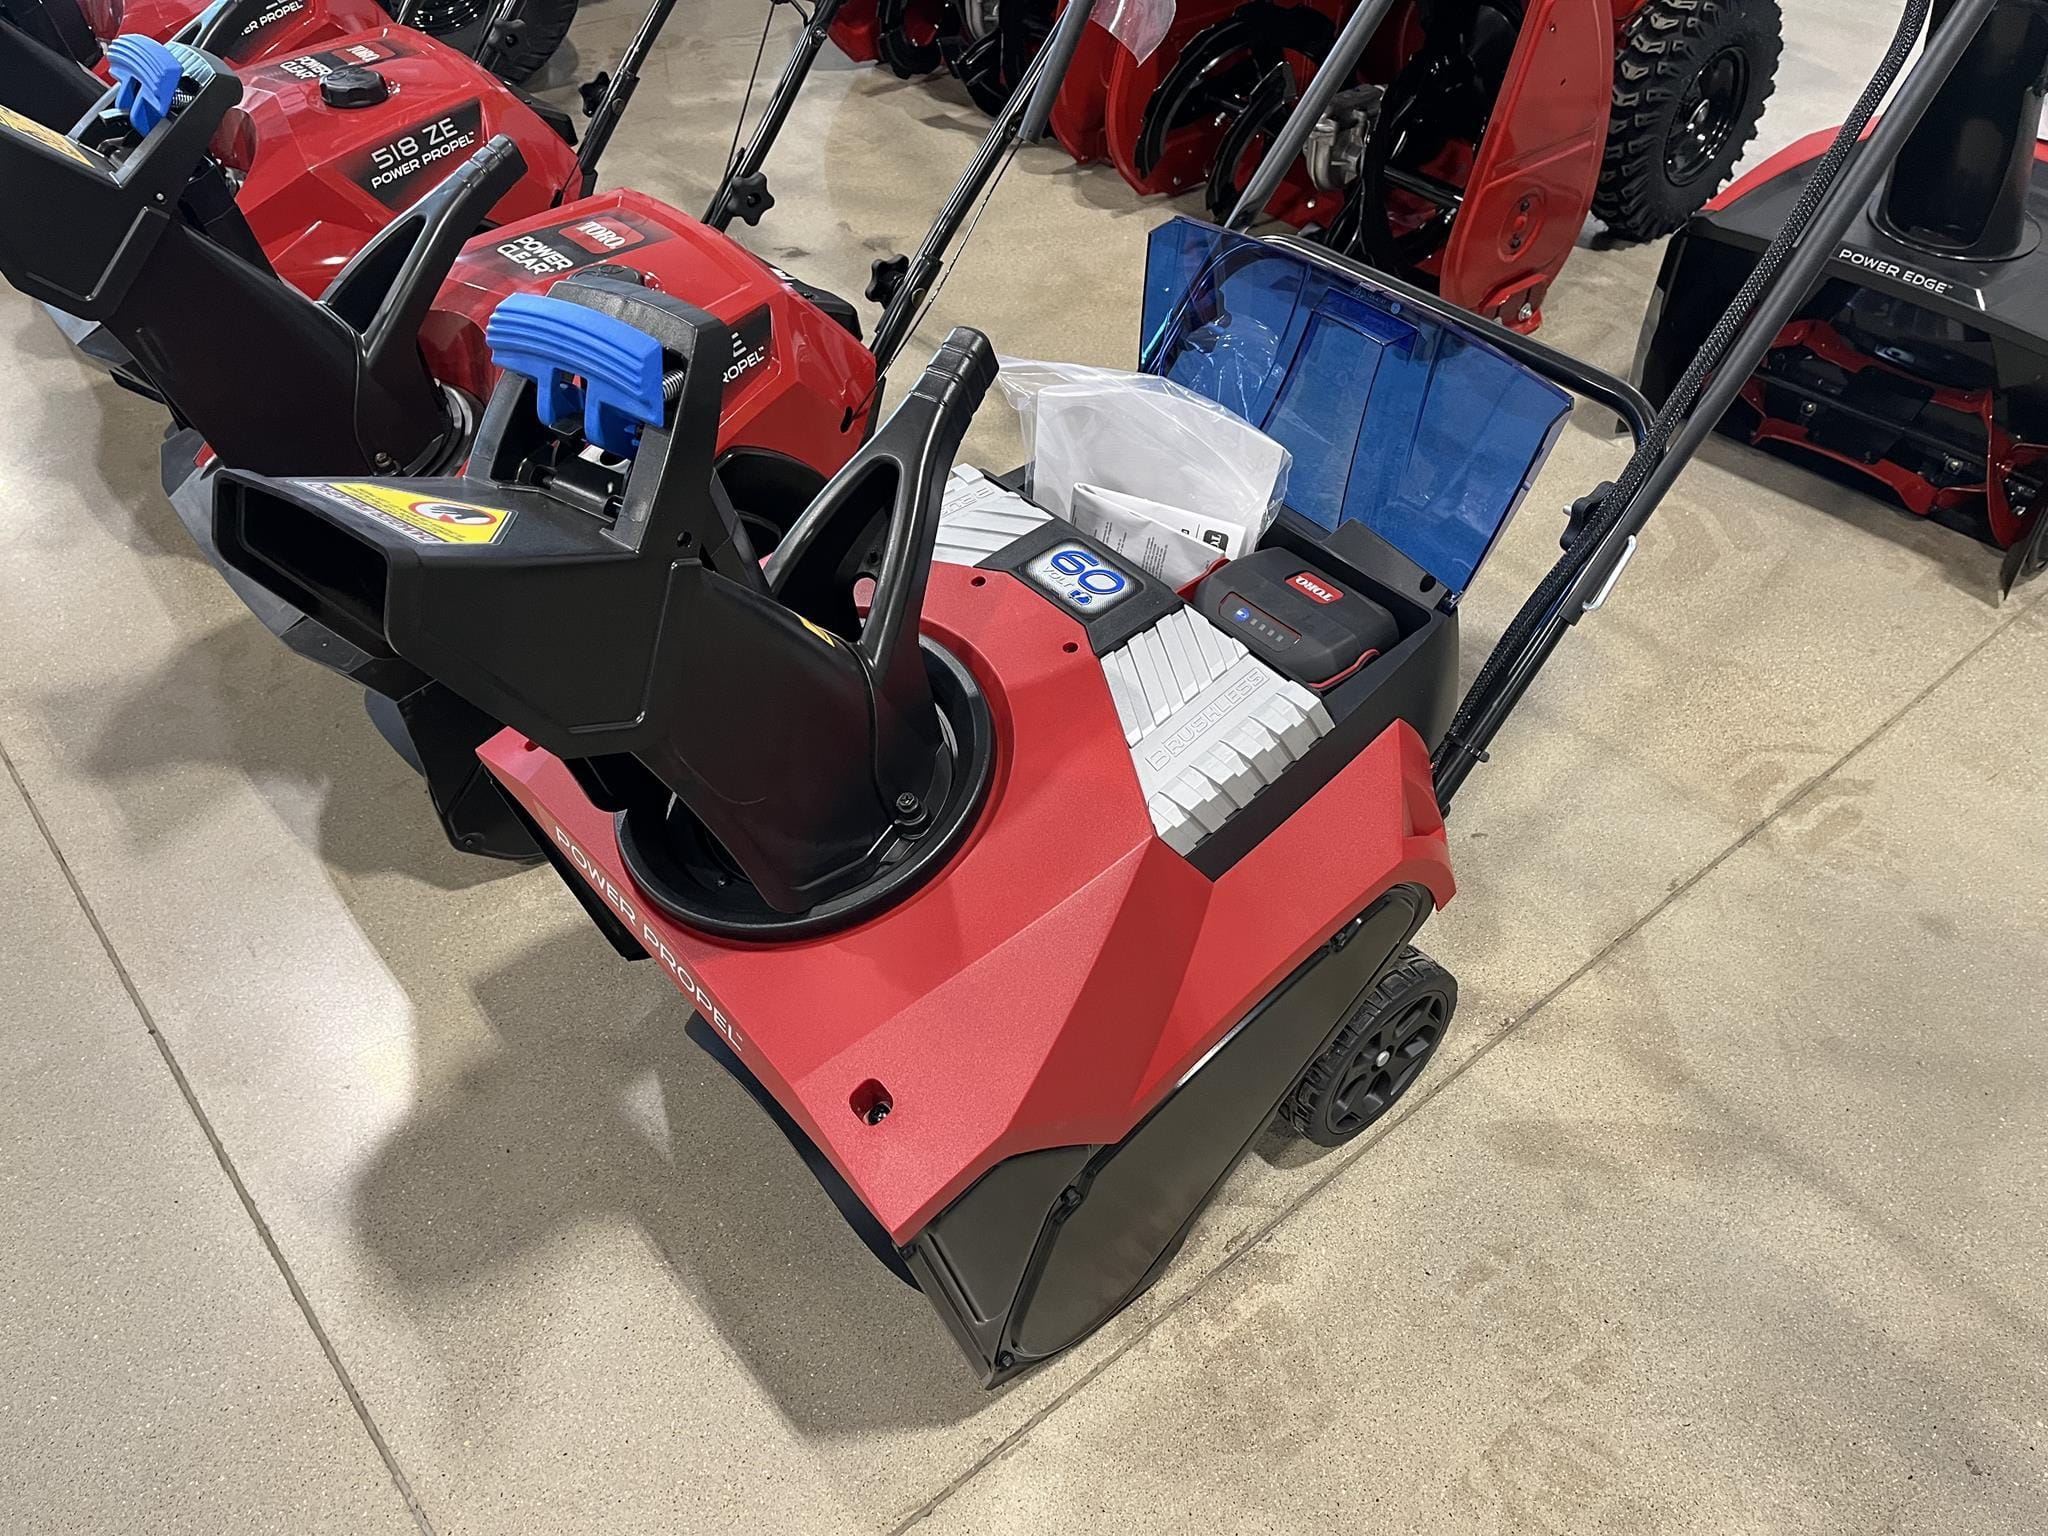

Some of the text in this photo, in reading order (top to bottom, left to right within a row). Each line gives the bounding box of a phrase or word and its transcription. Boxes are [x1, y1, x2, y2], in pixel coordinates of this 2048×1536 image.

[259, 1, 304, 26] PROPEL
[294, 55, 333, 76] POWER
[345, 44, 380, 63] TORO
[280, 61, 315, 79] CLEAR
[371, 117, 458, 170] 518 ZE
[371, 133, 475, 189] POWER PROPEL
[575, 220, 627, 249] TORO
[496, 243, 553, 275] CLEAR
[513, 235, 574, 271] POWER
[1839, 248, 1948, 294] POWER EDGE
[1042, 565, 1075, 588] VOLT
[1050, 550, 1126, 596] 60
[1295, 575, 1335, 602] TORO
[1145, 667, 1269, 772] BRUSHLESS
[555, 826, 742, 1052] POWER PROPEL
